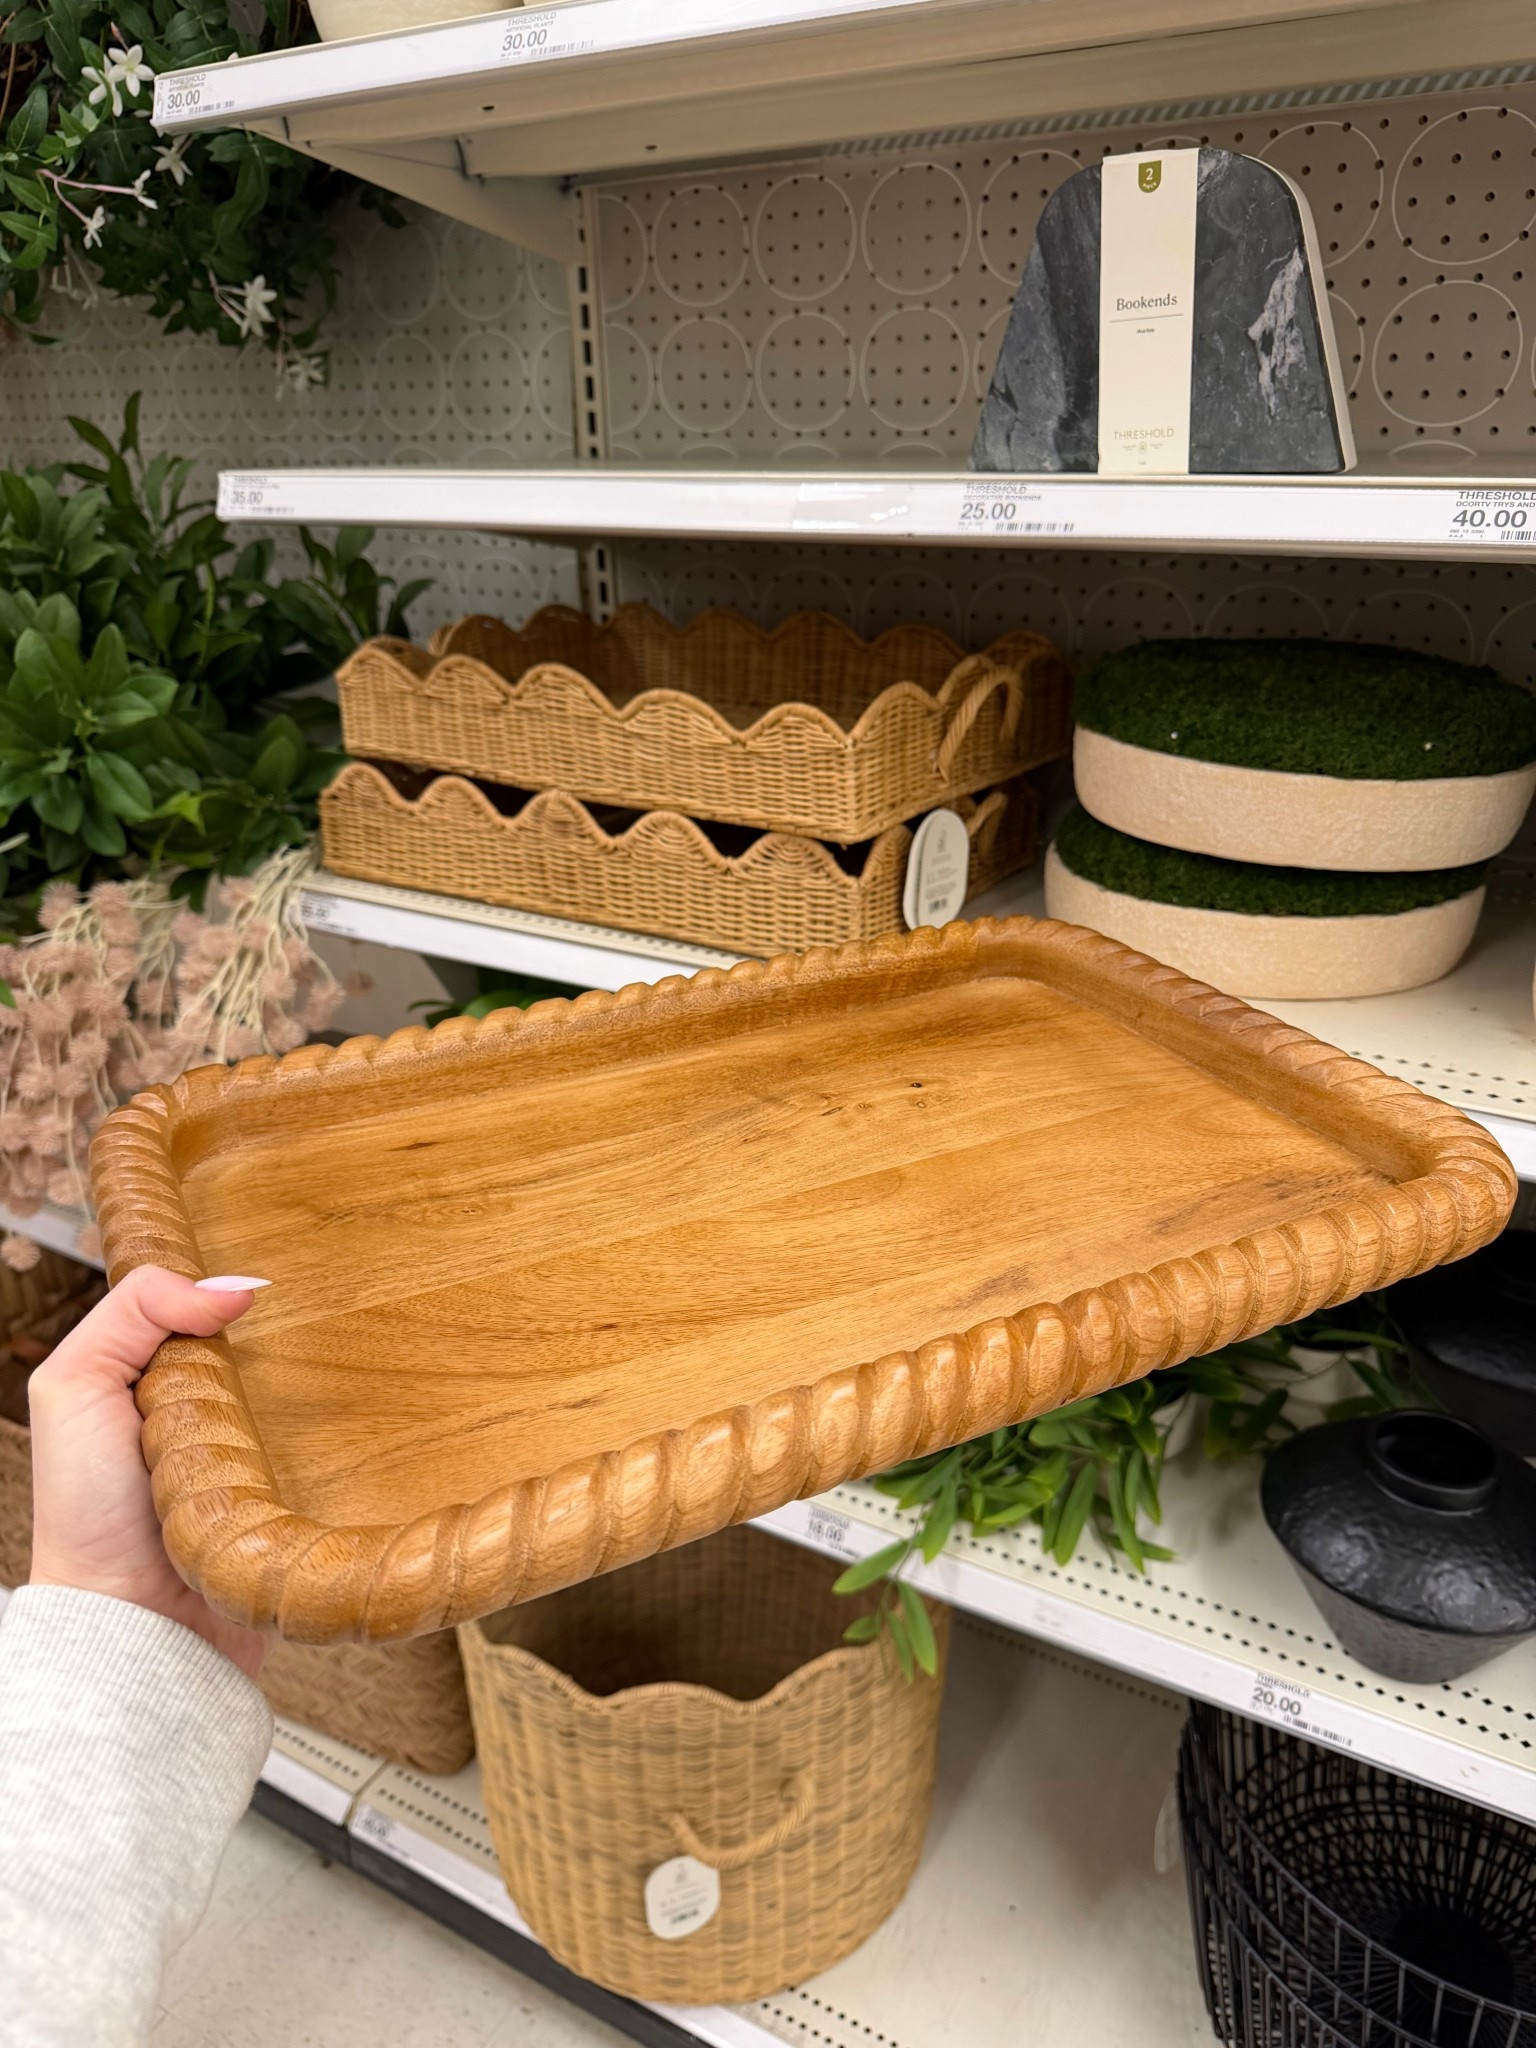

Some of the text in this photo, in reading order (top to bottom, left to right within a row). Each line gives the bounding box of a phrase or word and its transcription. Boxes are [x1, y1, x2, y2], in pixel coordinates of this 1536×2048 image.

[508, 11, 557, 27] THRESHOLD
[502, 29, 547, 51] 30.00
[169, 73, 206, 87] THRESHOLD
[168, 89, 200, 110] 30.00
[1145, 167, 1154, 181] 2
[1116, 293, 1178, 311] Bookends
[1113, 428, 1174, 440] THRESHOLD
[966, 485, 1028, 495] THRESHOLD
[1459, 491, 1536, 501] THRESHOLD
[960, 503, 1016, 520] 25.00
[1452, 509, 1528, 529] 40.00
[1257, 1671, 1310, 1699] THRESHOLD
[1252, 1686, 1302, 1716] 20.00
